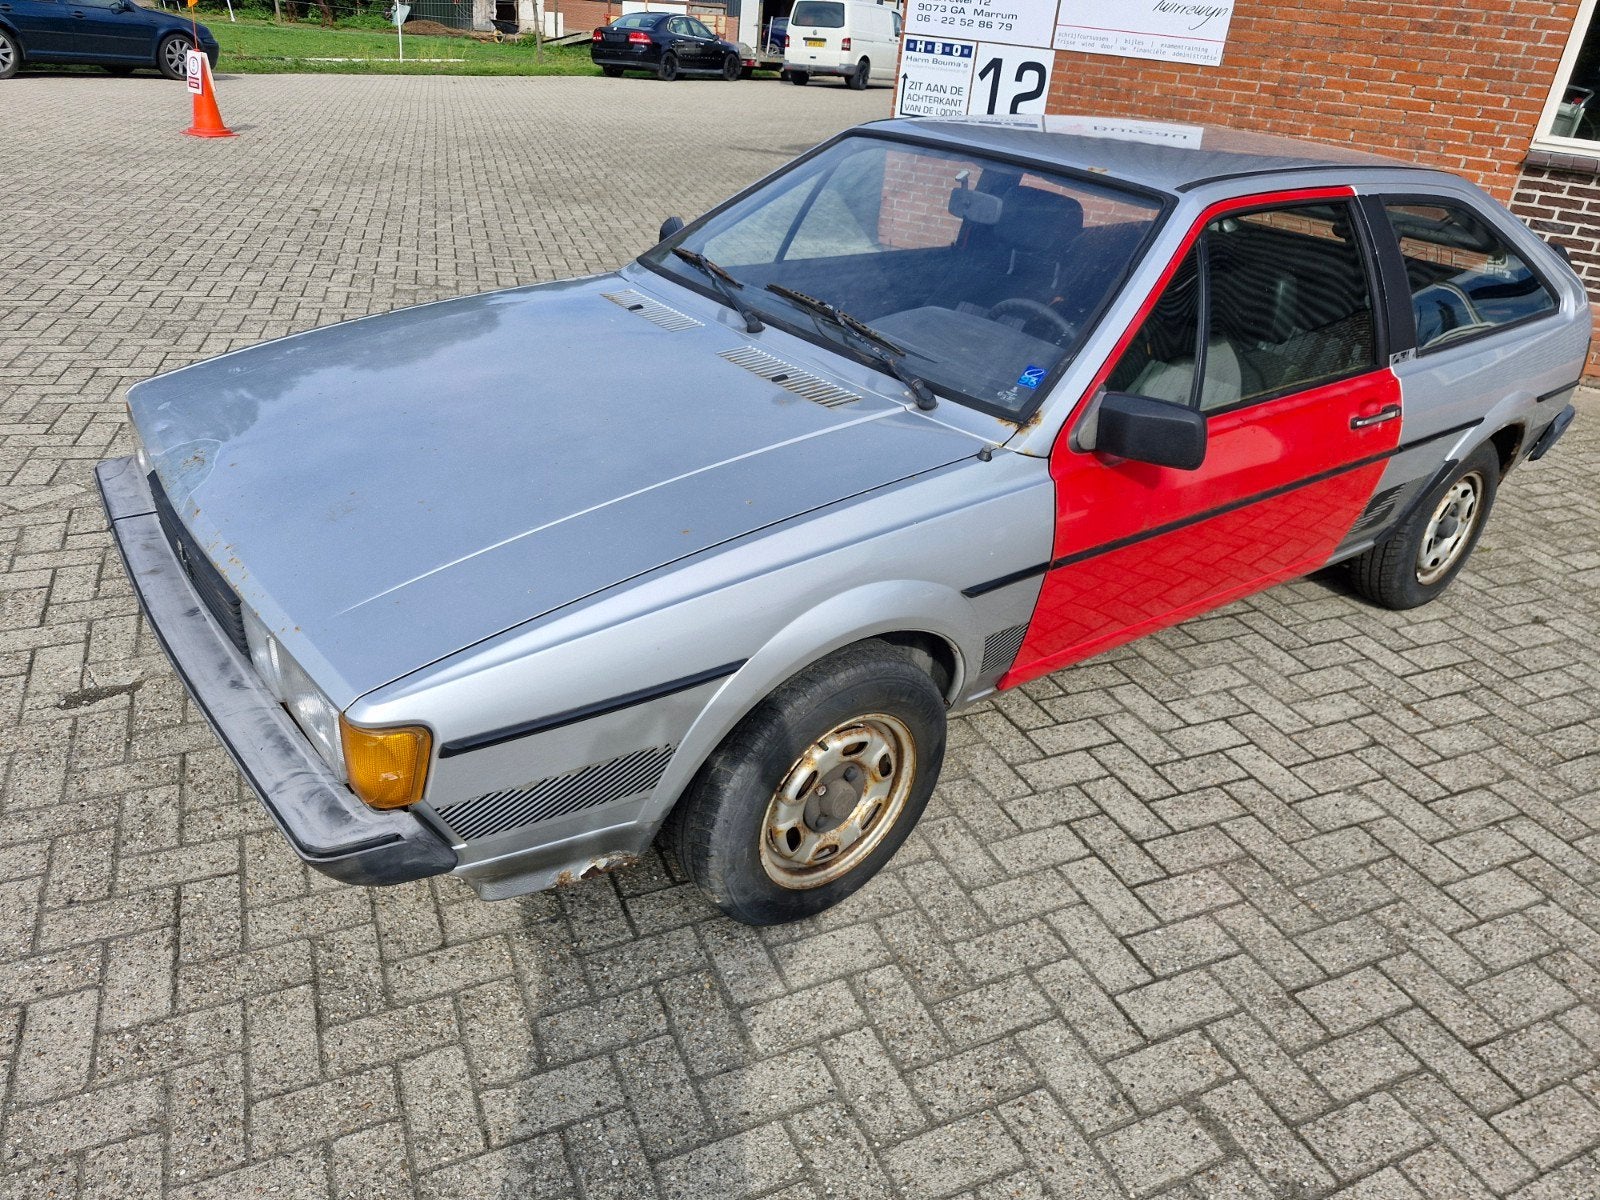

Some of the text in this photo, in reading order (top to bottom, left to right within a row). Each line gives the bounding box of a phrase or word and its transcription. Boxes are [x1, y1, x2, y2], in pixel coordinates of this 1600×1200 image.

[917, 3, 1018, 20] 9073 GA Marrum
[916, 14, 931, 22] 06
[941, 16, 955, 25] 22
[959, 19, 974, 27] 52
[978, 20, 993, 29] 86
[998, 22, 1013, 31] 79
[906, 55, 969, 68] Harm Bouma's
[908, 80, 964, 96] ZIT AAN DE
[978, 57, 1047, 114] 12
[906, 92, 963, 107] ACHTERKANT
[904, 103, 962, 116] VAN DE LOODS
